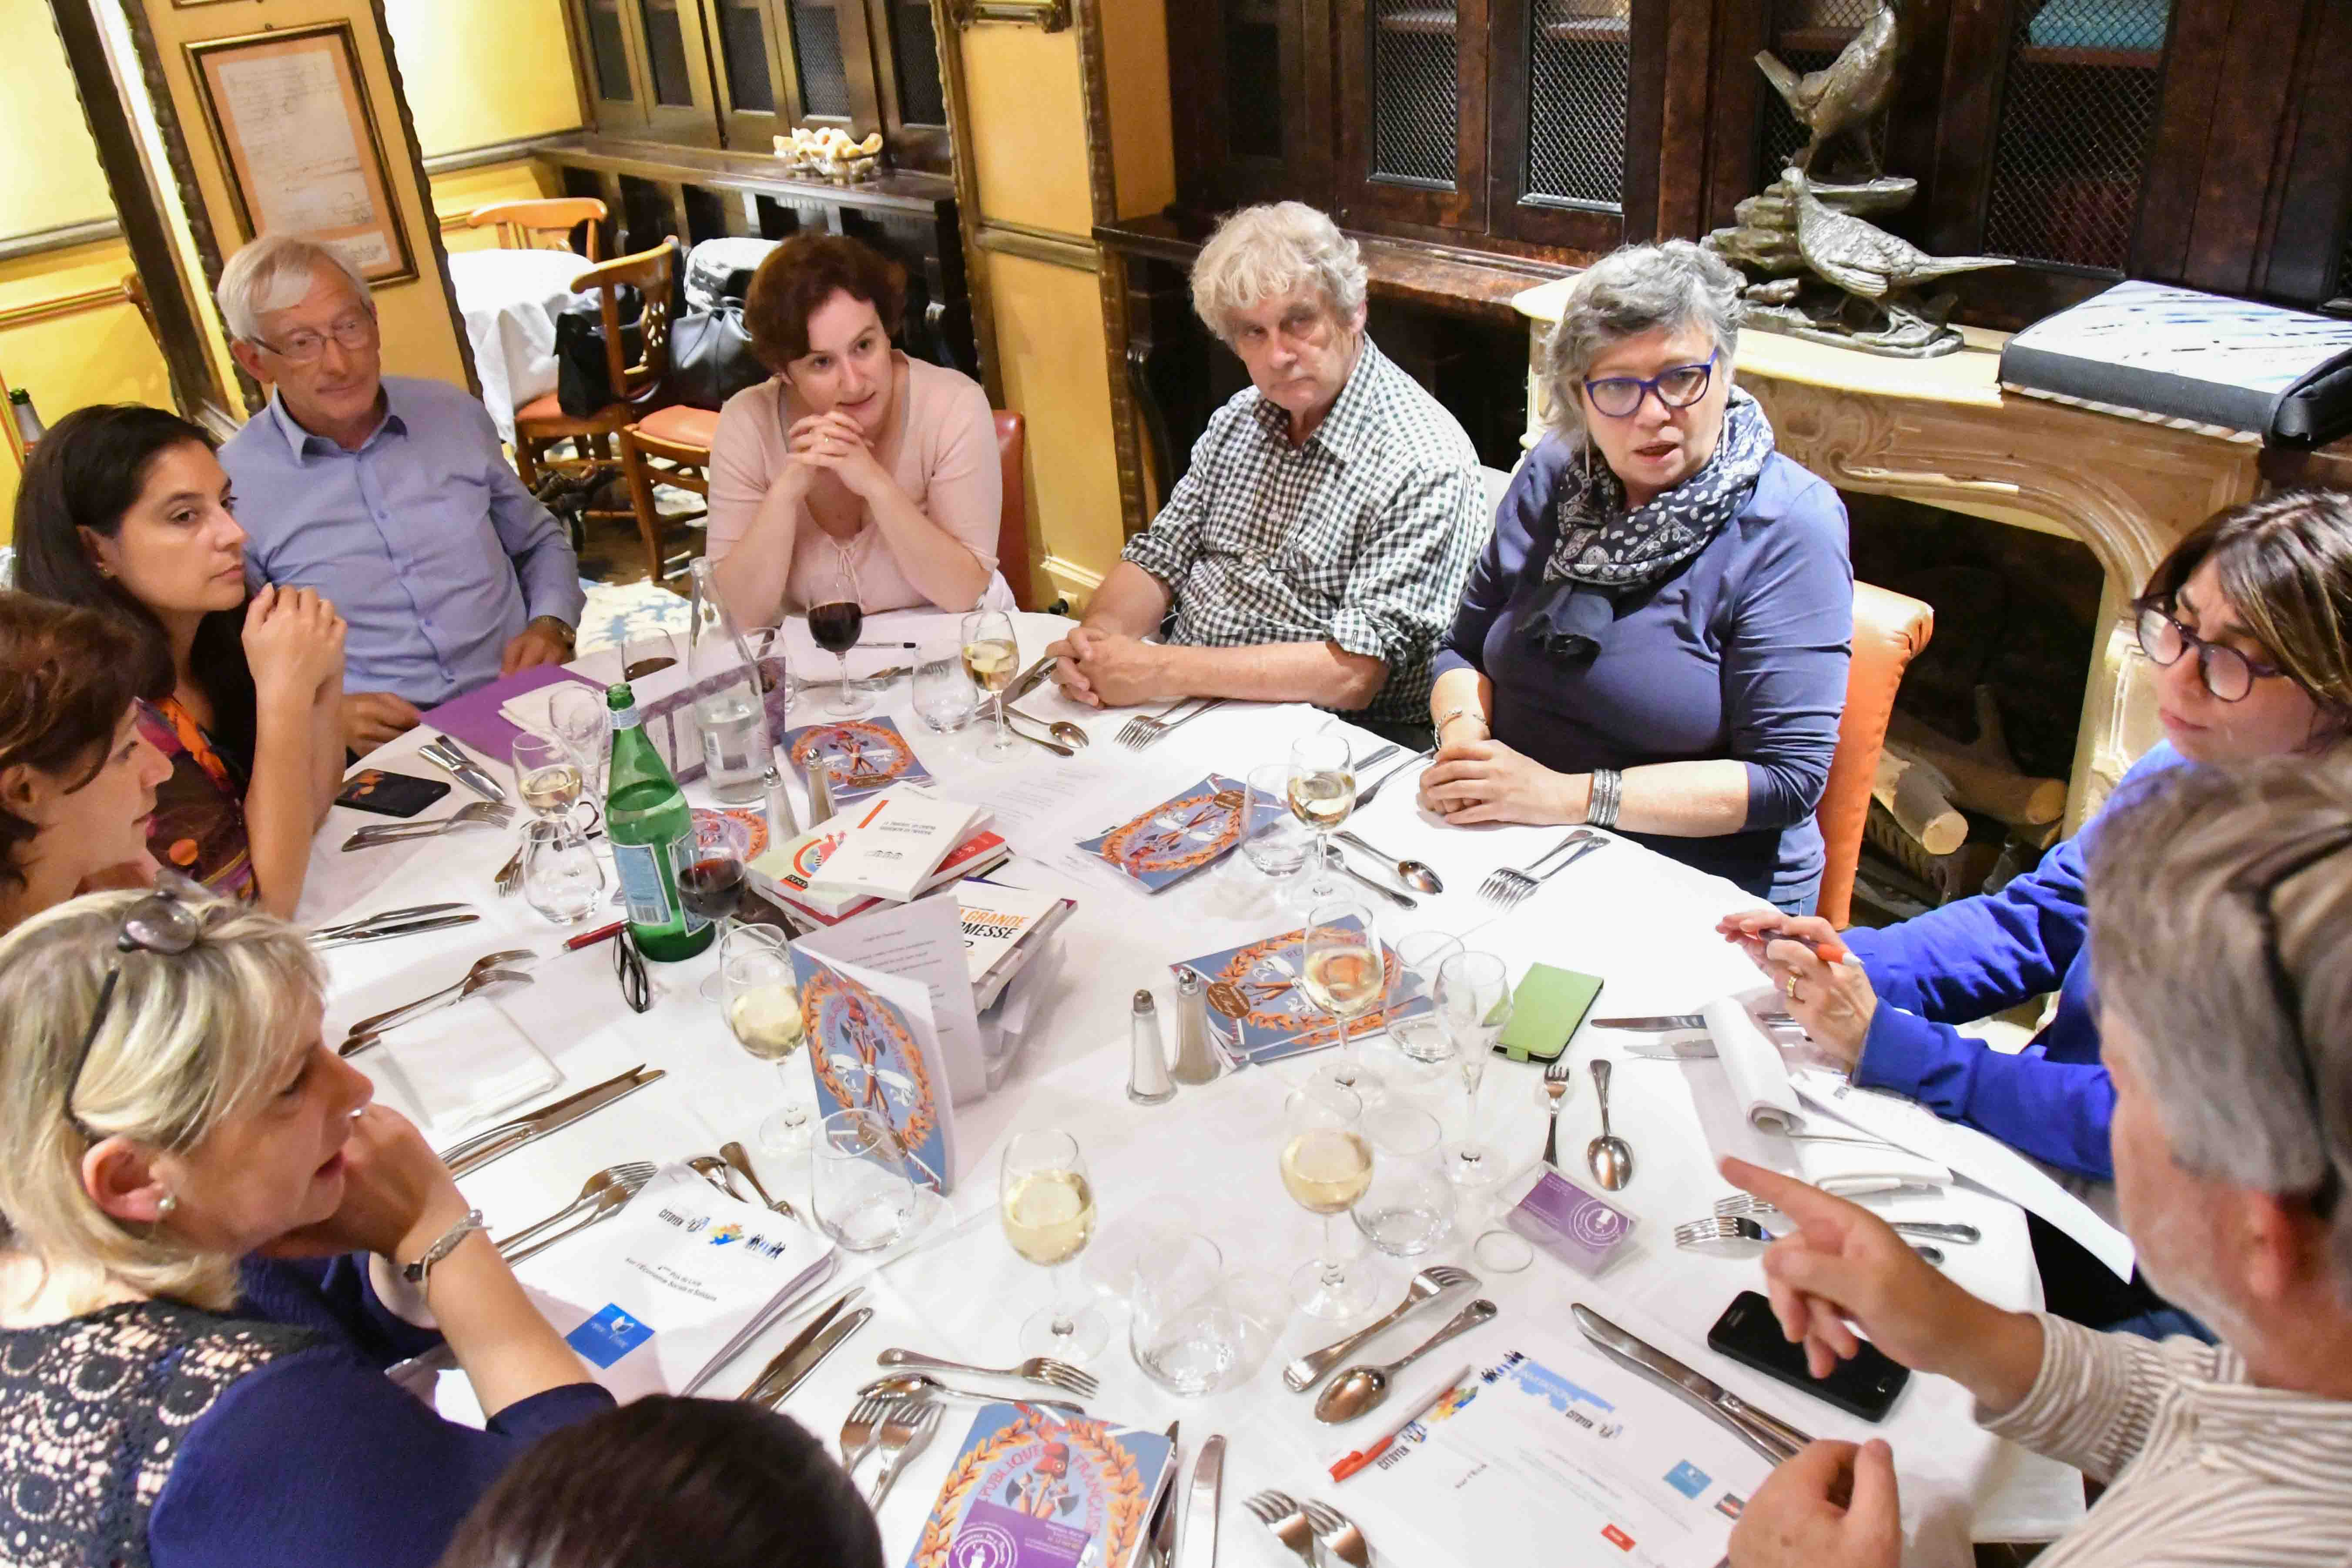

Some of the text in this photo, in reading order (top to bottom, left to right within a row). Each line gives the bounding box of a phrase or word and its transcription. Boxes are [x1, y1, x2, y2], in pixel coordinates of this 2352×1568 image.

[965, 910, 1030, 928] GRANDE
[658, 1209, 684, 1226] CITOYEN
[1377, 1445, 1411, 1470] CITOYEN
